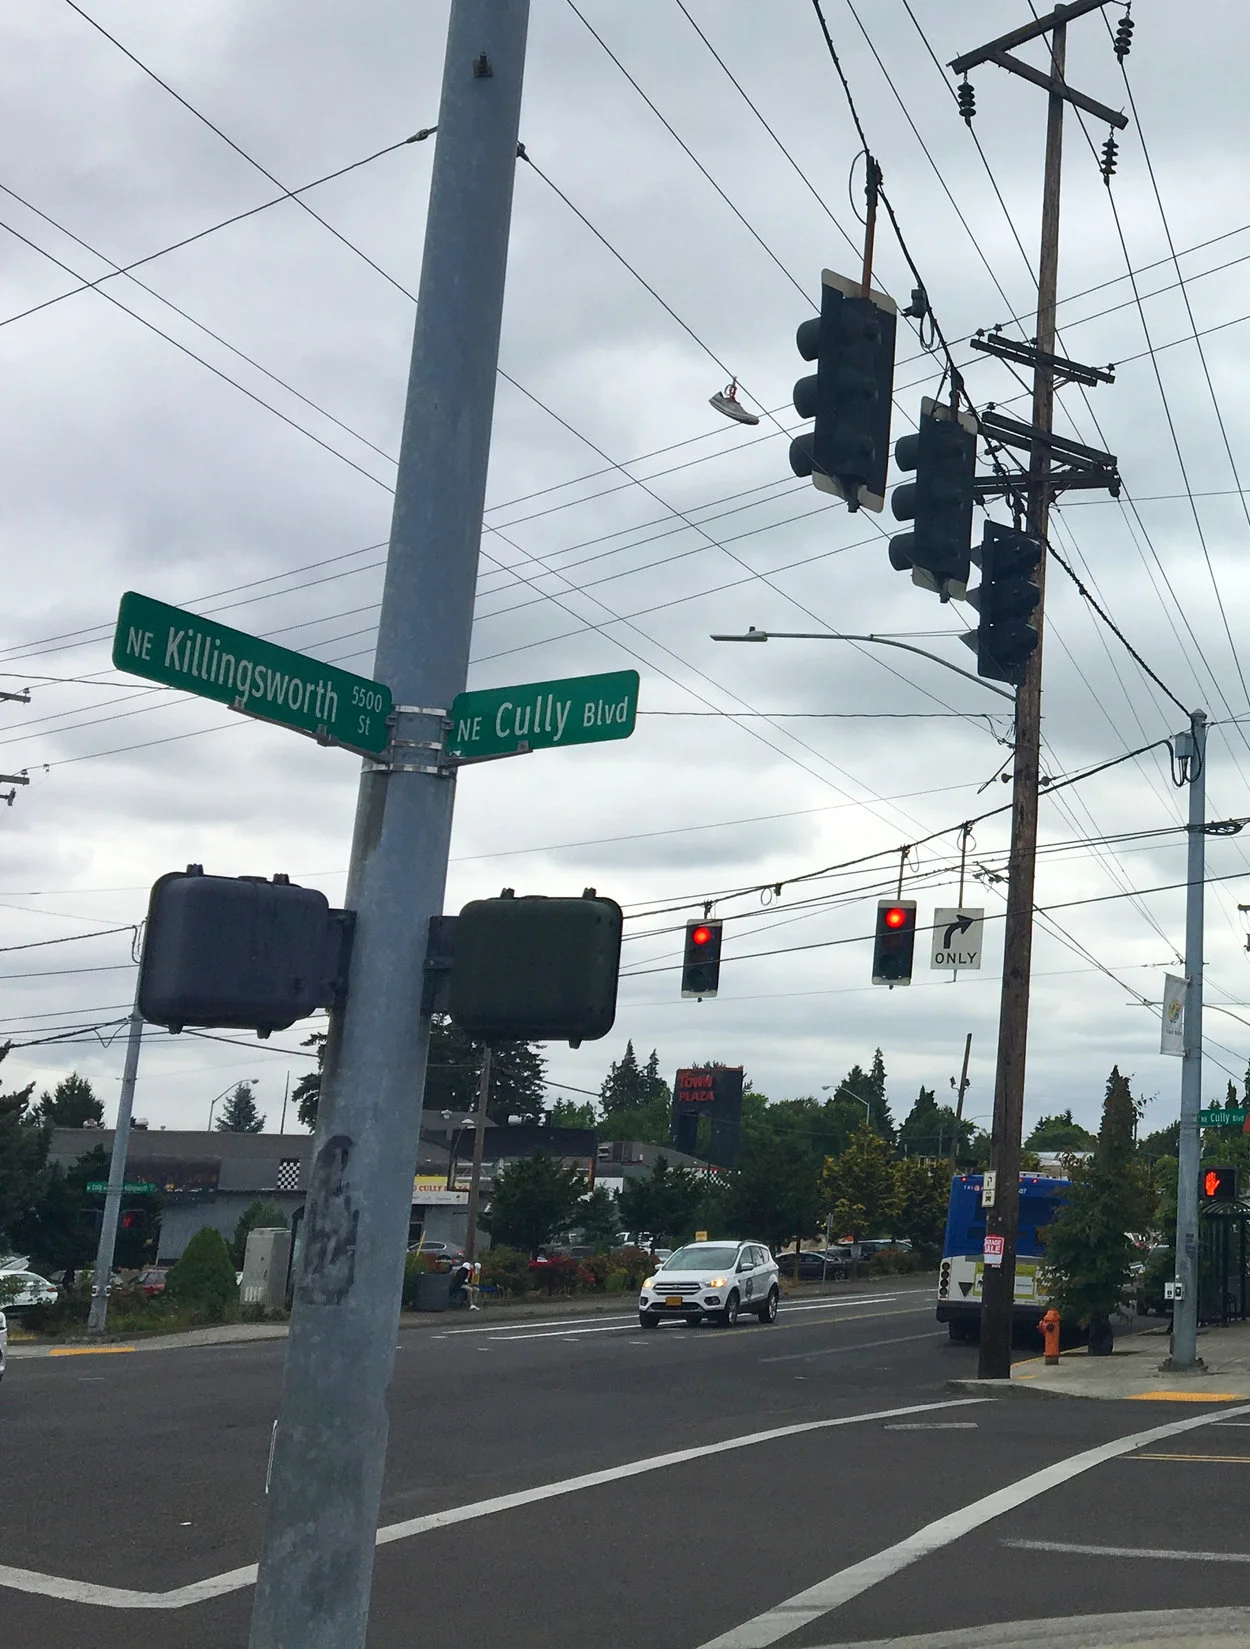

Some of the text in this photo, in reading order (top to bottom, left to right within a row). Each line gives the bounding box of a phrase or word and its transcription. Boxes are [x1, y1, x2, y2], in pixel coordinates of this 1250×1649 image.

[126, 626, 338, 723] NE Killingsworth
[352, 686, 383, 713] 5500
[357, 715, 371, 735] St
[456, 694, 629, 742] NE Cully Blvd
[935, 952, 978, 964] ONLY
[679, 1074, 712, 1088] TOWN
[679, 1091, 715, 1101] PLAZA
[1210, 1112, 1230, 1125] Cully
